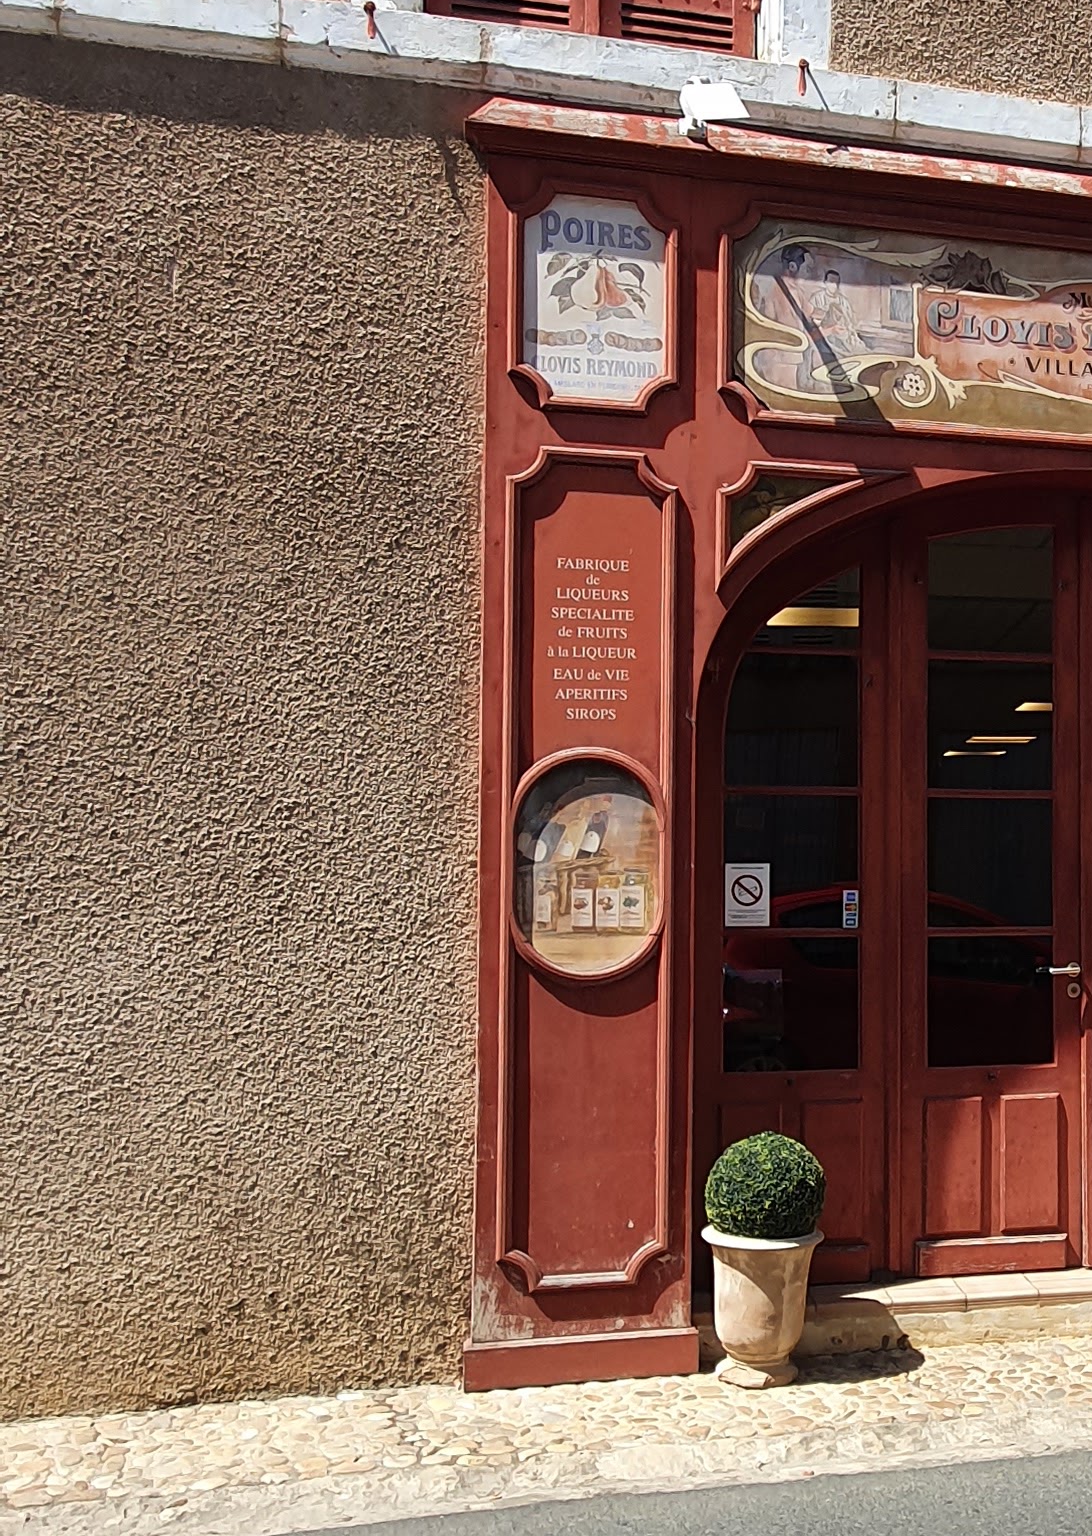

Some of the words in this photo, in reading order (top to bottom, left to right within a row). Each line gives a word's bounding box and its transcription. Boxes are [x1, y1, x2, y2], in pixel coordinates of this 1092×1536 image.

[538, 210, 652, 254] POIRES
[925, 298, 1075, 352] CLOVIS
[586, 357, 658, 378] REYMOND
[557, 557, 630, 573] FABRIQUE
[586, 574, 600, 586] de
[556, 587, 629, 602] LIQUEURS
[551, 606, 635, 621] SPECIALITE
[558, 626, 573, 638] de
[577, 627, 628, 639] FRUITS
[558, 646, 569, 657] la
[572, 646, 637, 660] LIQUEUR
[553, 668, 583, 680] EAU
[587, 669, 601, 680] de
[605, 669, 629, 681] VIE
[555, 688, 628, 701] APERITIFS
[566, 708, 617, 720] SIROPS
